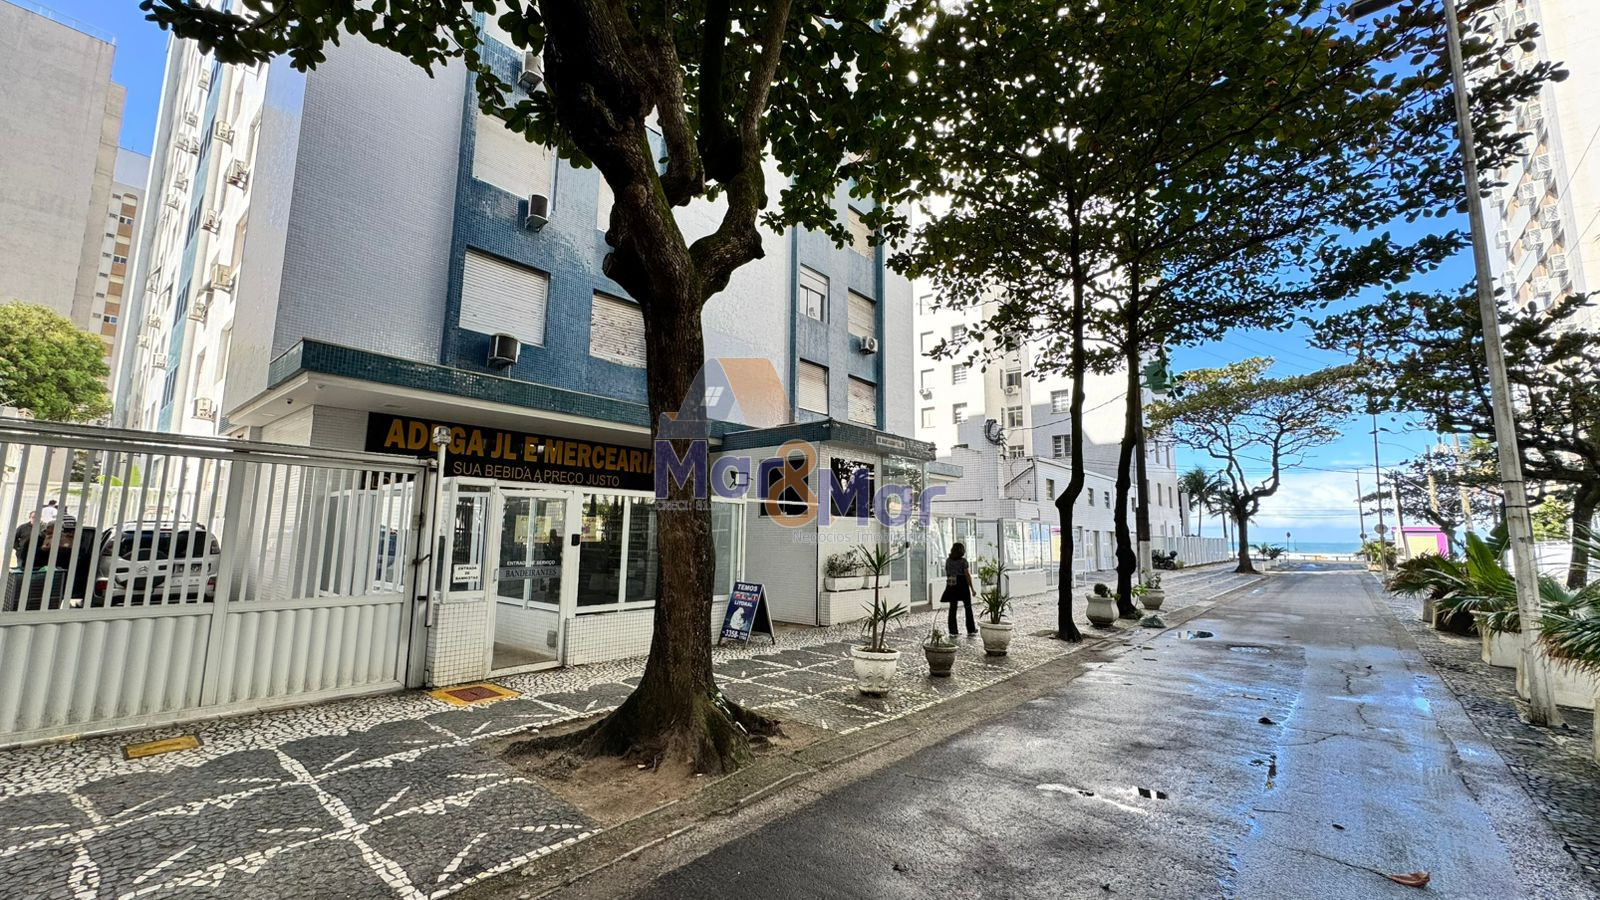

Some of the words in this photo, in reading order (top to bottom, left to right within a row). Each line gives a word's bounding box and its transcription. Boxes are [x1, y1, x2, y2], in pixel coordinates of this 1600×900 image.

[490, 432, 517, 461] JL
[523, 436, 539, 462] E
[453, 461, 482, 477] SUA
[484, 463, 532, 481] BEBIDA
[533, 468, 543, 481] A
[544, 469, 584, 485] PREÇO
[586, 473, 620, 488] JUSTO
[505, 567, 557, 577] BANDEIRANTES
[737, 584, 758, 592] TEMOS
